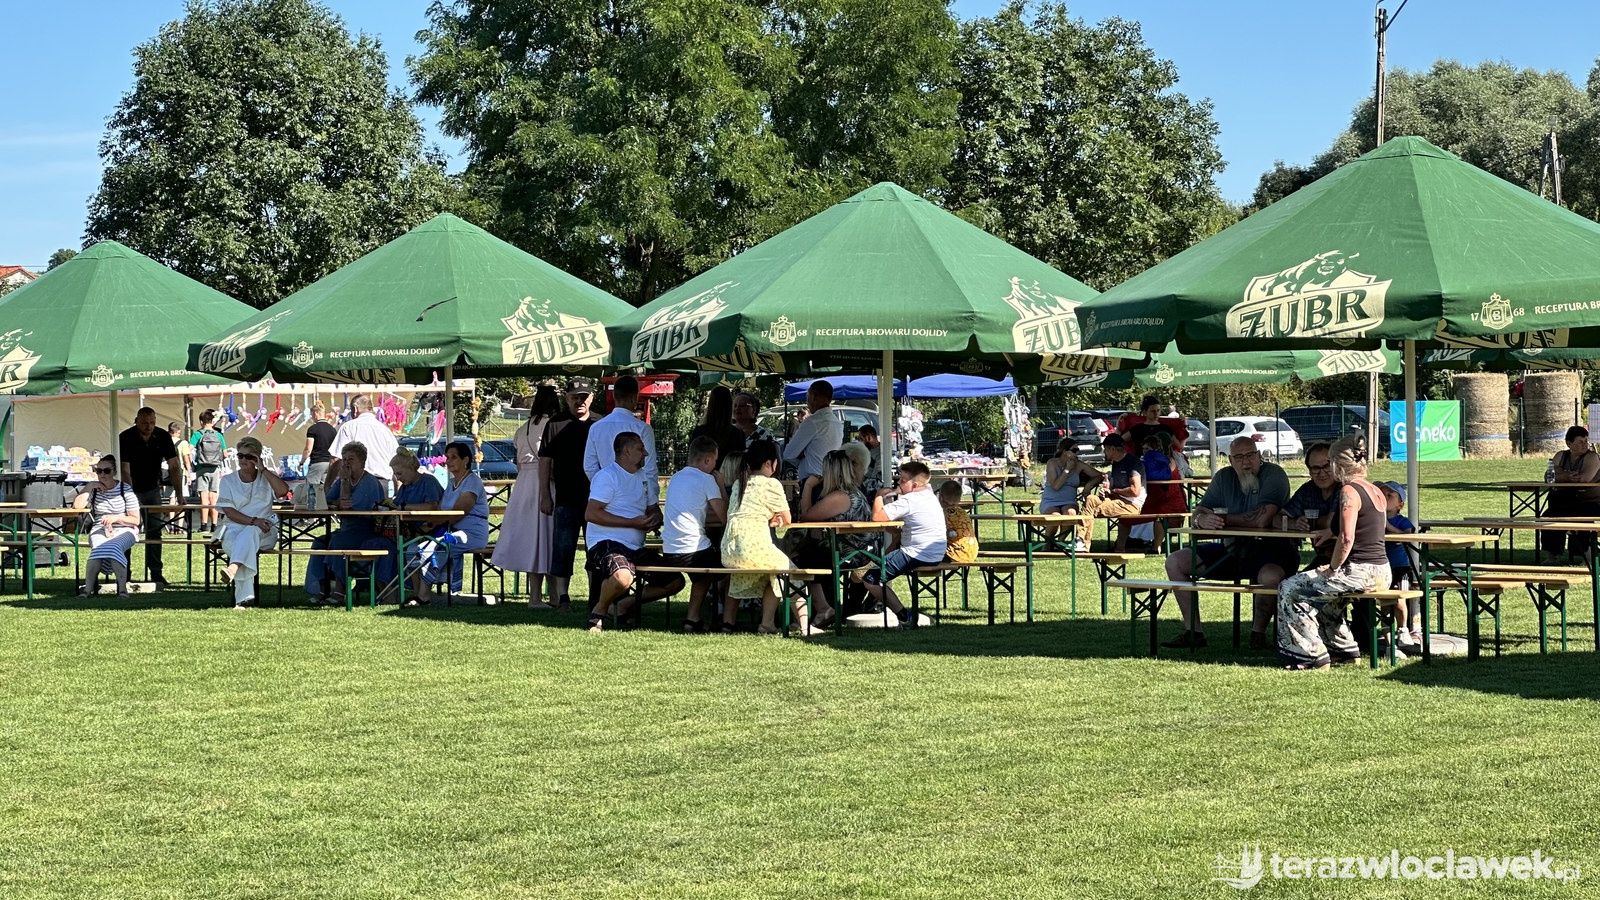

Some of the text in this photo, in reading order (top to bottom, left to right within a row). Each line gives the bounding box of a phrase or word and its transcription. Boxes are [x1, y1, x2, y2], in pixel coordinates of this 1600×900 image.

[1470, 312, 1479, 321] 17
[1513, 307, 1525, 317] 68
[1534, 301, 1589, 315] RECEPTURA
[761, 330, 768, 338] 17
[797, 329, 807, 337] 68
[815, 328, 865, 336] RECEPTURA
[866, 328, 910, 336] BROWARU
[912, 328, 948, 337] DOJLIDY
[286, 353, 292, 361] 17
[329, 350, 371, 359] RECEPTURA
[371, 348, 409, 357] BROWARU
[410, 347, 441, 356] DOJLIDY
[129, 370, 169, 378] RECEPTURA
